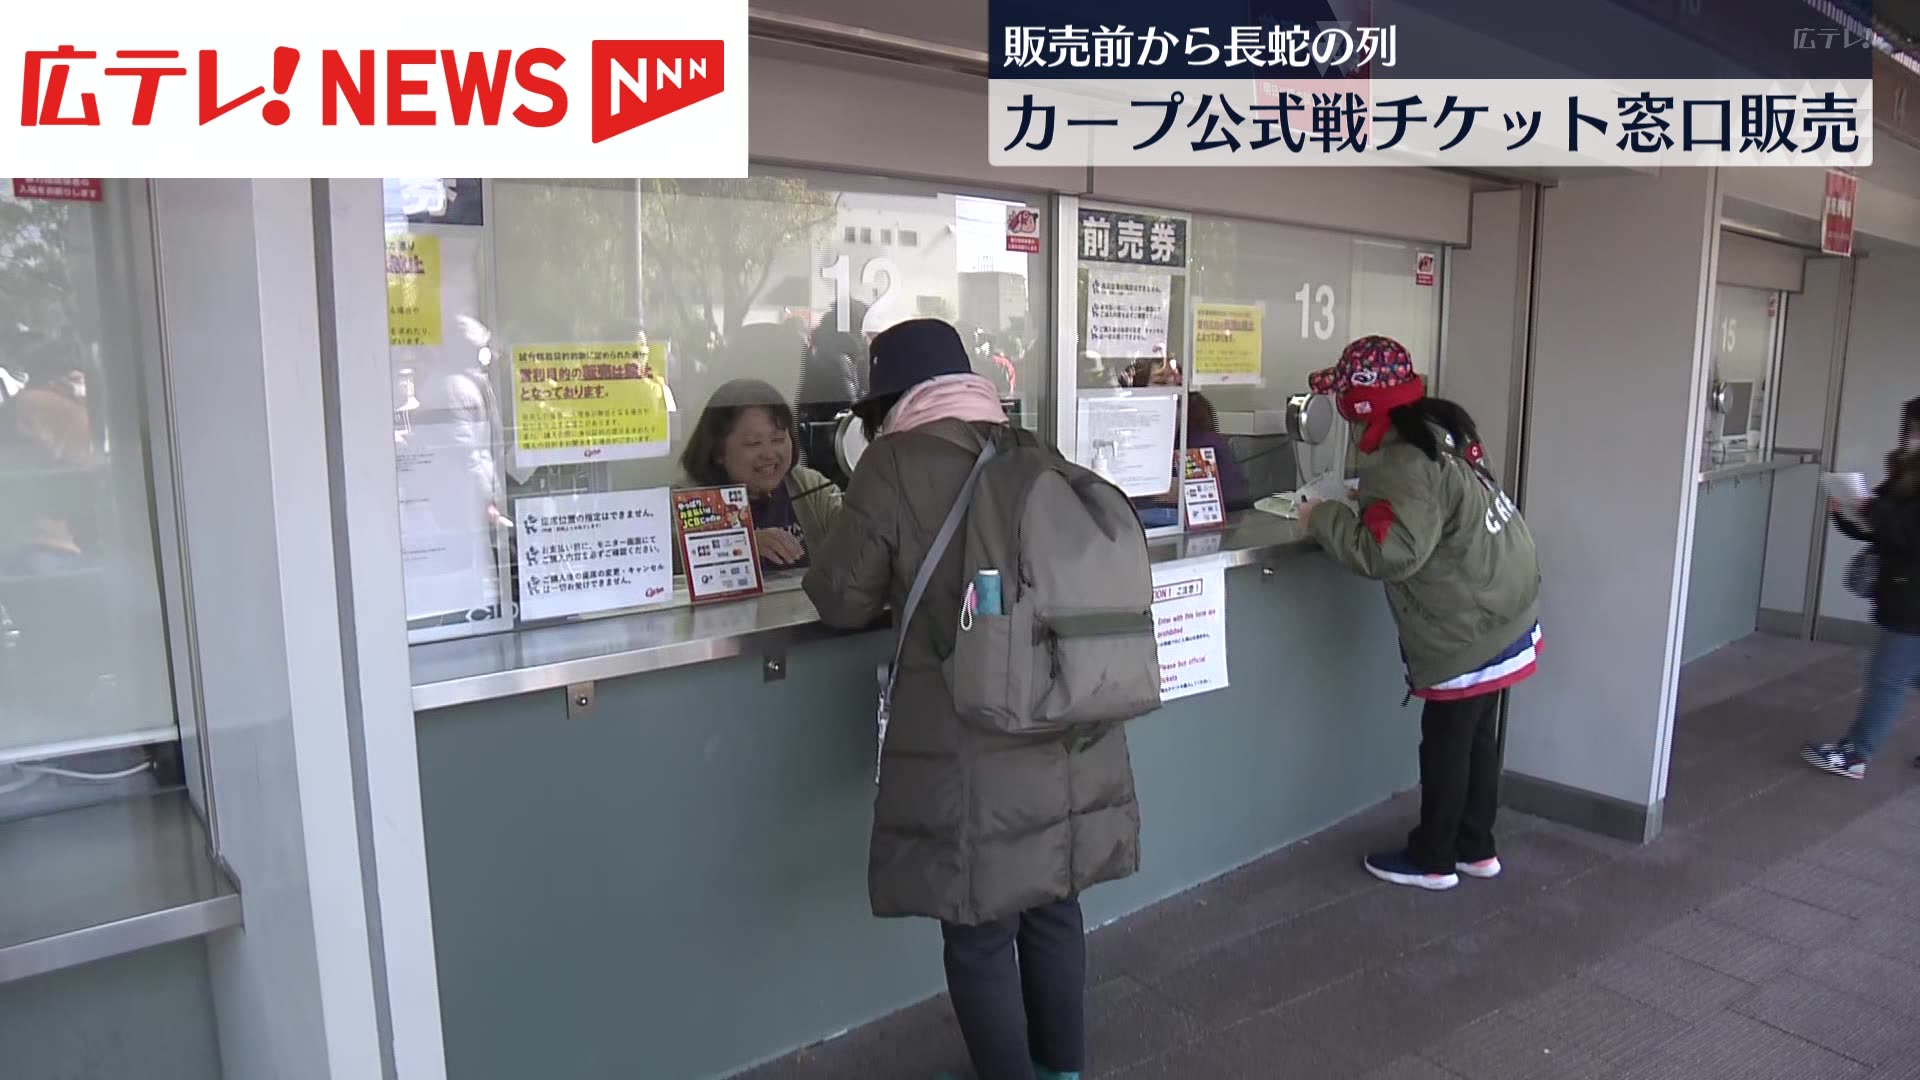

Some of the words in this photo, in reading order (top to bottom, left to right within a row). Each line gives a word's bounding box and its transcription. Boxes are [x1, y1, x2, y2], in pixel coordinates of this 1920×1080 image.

[1082, 215, 1177, 262] 前売券
[1295, 283, 1335, 340] 13
[1720, 316, 1737, 353] 15
[520, 384, 609, 401] となっております。
[542, 536, 656, 554] お支払い前に、モニター画面にて
[542, 545, 661, 565] ご購入内容を必ずご確認ください。
[542, 564, 665, 584] ご購入後の座席の変更・キャンセル
[543, 577, 632, 594] は一切お受けできません。
